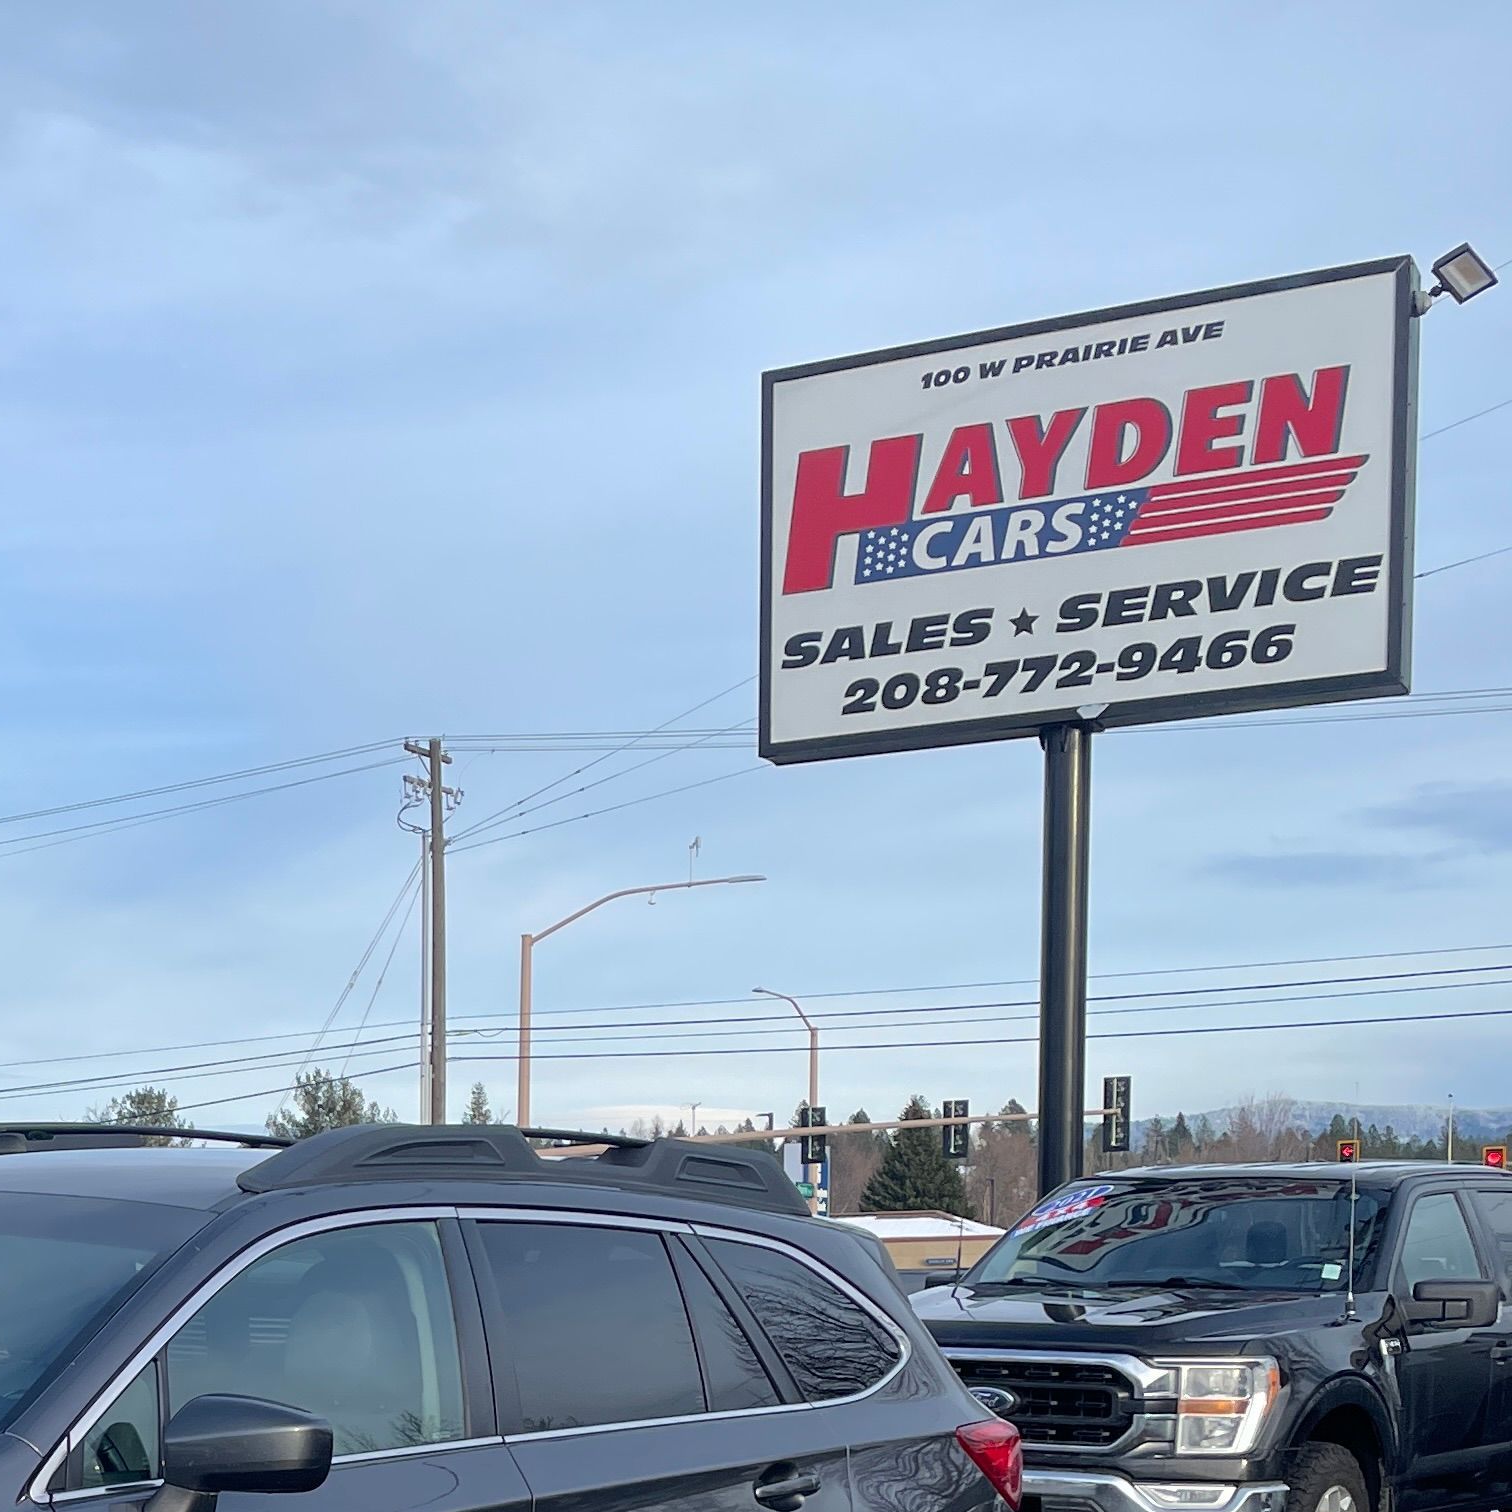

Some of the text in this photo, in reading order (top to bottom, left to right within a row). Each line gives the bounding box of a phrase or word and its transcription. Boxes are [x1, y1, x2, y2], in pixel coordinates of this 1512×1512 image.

[921, 320, 1225, 391] 100 W PRAIRIE AVE
[782, 364, 1353, 596] HAYDEN
[911, 501, 1088, 572] CARS
[781, 554, 1385, 670] SALES SERVICE
[841, 624, 1297, 716] 208-772-9466
